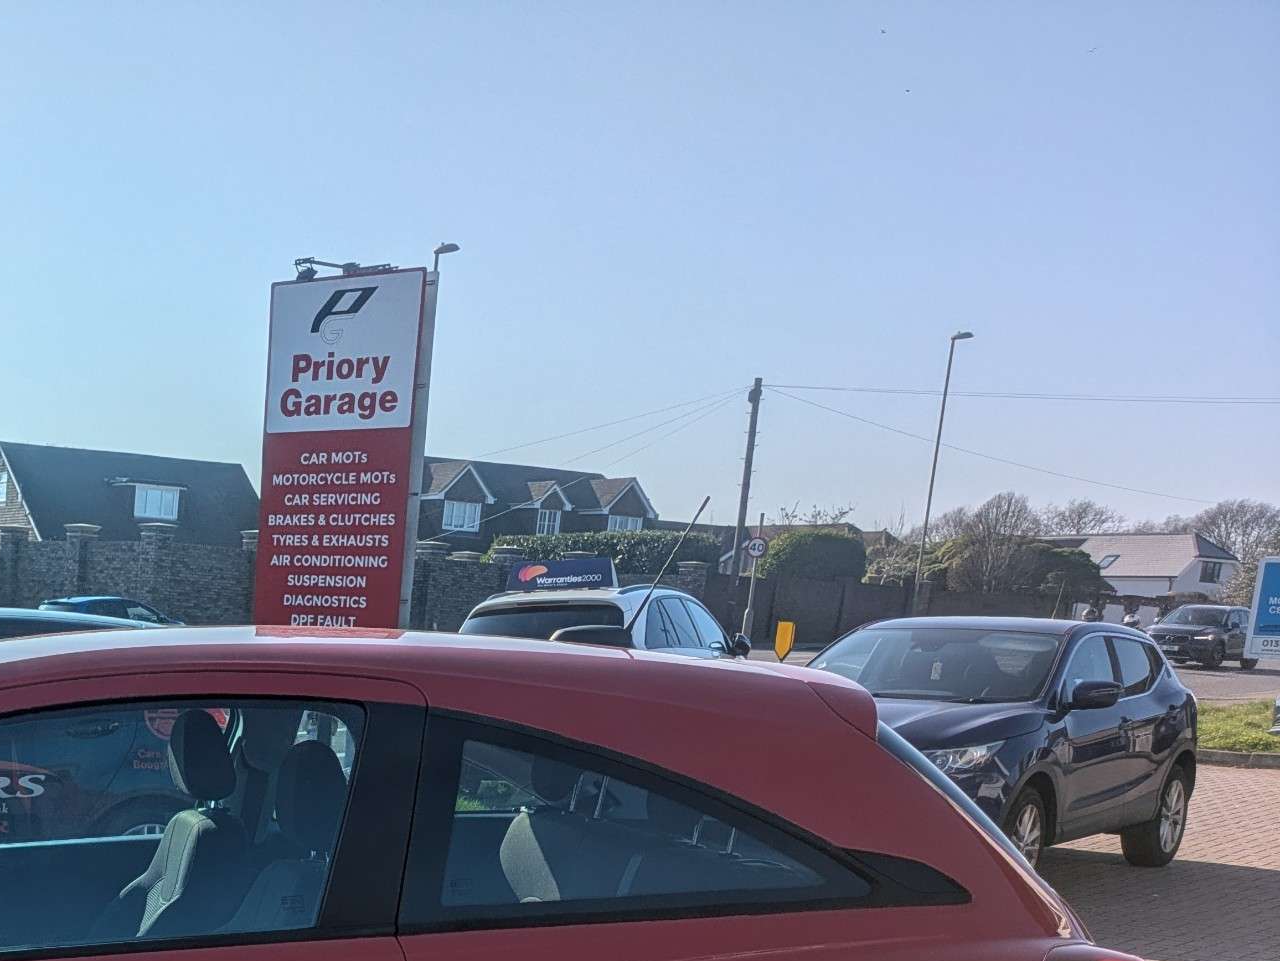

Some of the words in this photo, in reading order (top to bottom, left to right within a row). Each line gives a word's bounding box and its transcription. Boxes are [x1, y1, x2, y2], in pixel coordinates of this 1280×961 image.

[291, 351, 391, 384] Priory
[280, 388, 398, 419] Garage
[300, 452, 328, 465] CAR
[331, 451, 368, 464] MOTs
[272, 472, 357, 486] MOTORCYCLE
[359, 471, 396, 484] MOTs
[284, 494, 309, 506] CAR
[312, 492, 381, 506] SERVICING
[268, 514, 315, 526] BRAKES
[318, 514, 326, 526] &
[329, 513, 396, 526] CLUTCHES
[272, 534, 309, 547] TYRES
[311, 534, 319, 547] &
[322, 534, 389, 547] EXHAUSTS
[749, 543, 764, 553] 40
[270, 555, 291, 566] AIR
[293, 555, 388, 568] CONDITIONING
[287, 574, 367, 588] SUSPENSION
[283, 594, 367, 608] DIAGNOSTICS
[290, 614, 314, 627] DPF
[317, 615, 356, 628] FAULT
